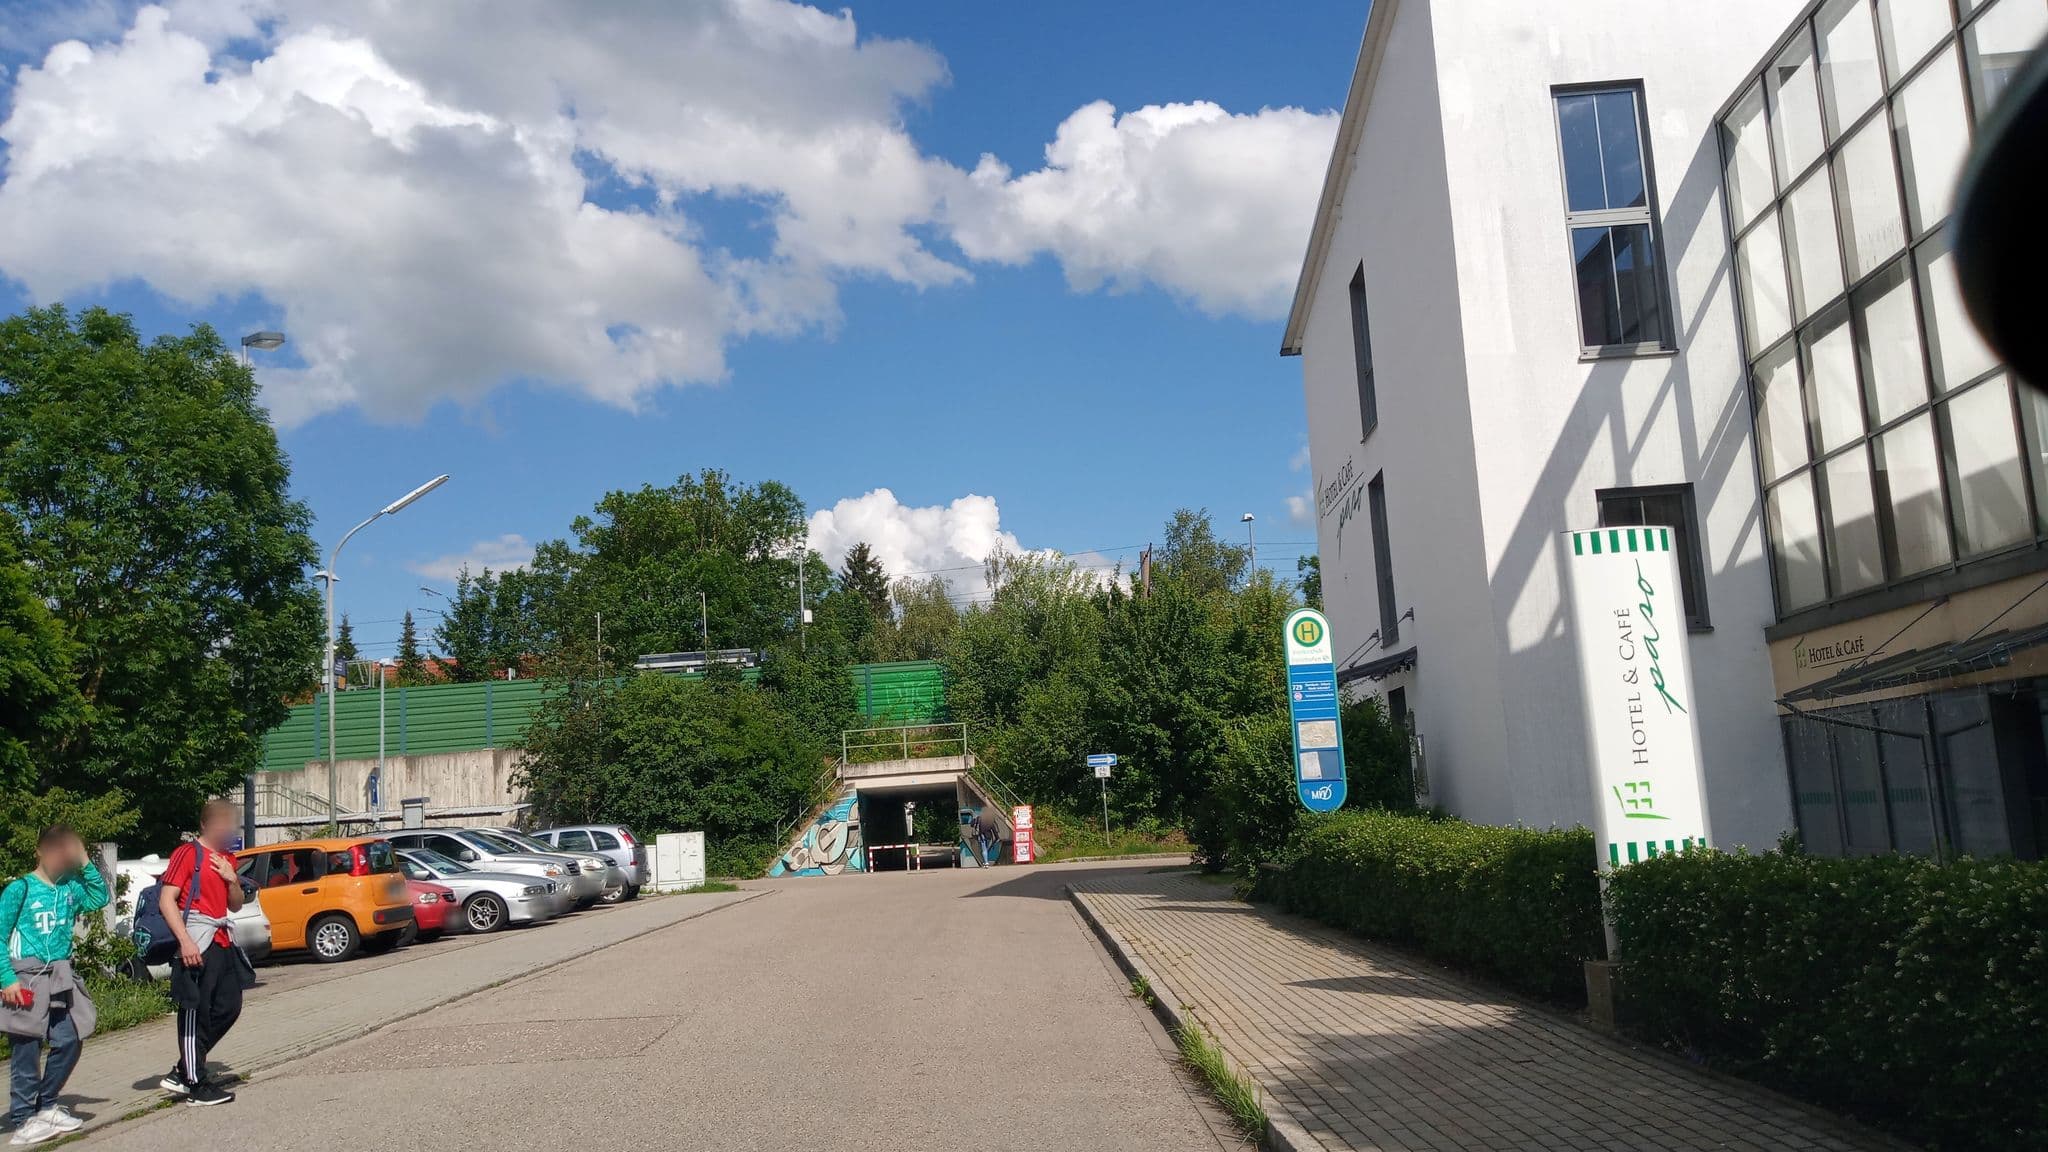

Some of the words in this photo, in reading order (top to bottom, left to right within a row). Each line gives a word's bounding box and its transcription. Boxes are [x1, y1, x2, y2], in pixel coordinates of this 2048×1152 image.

[1301, 623, 1315, 641] H
[1613, 607, 1635, 661] CAFÉ
[1635, 558, 1687, 715] paso
[1808, 645, 1835, 664] HOTEL
[1835, 642, 1844, 657] &
[1843, 635, 1865, 655] CAFÉ
[1622, 667, 1639, 685] &
[1628, 691, 1649, 765] HOTEL
